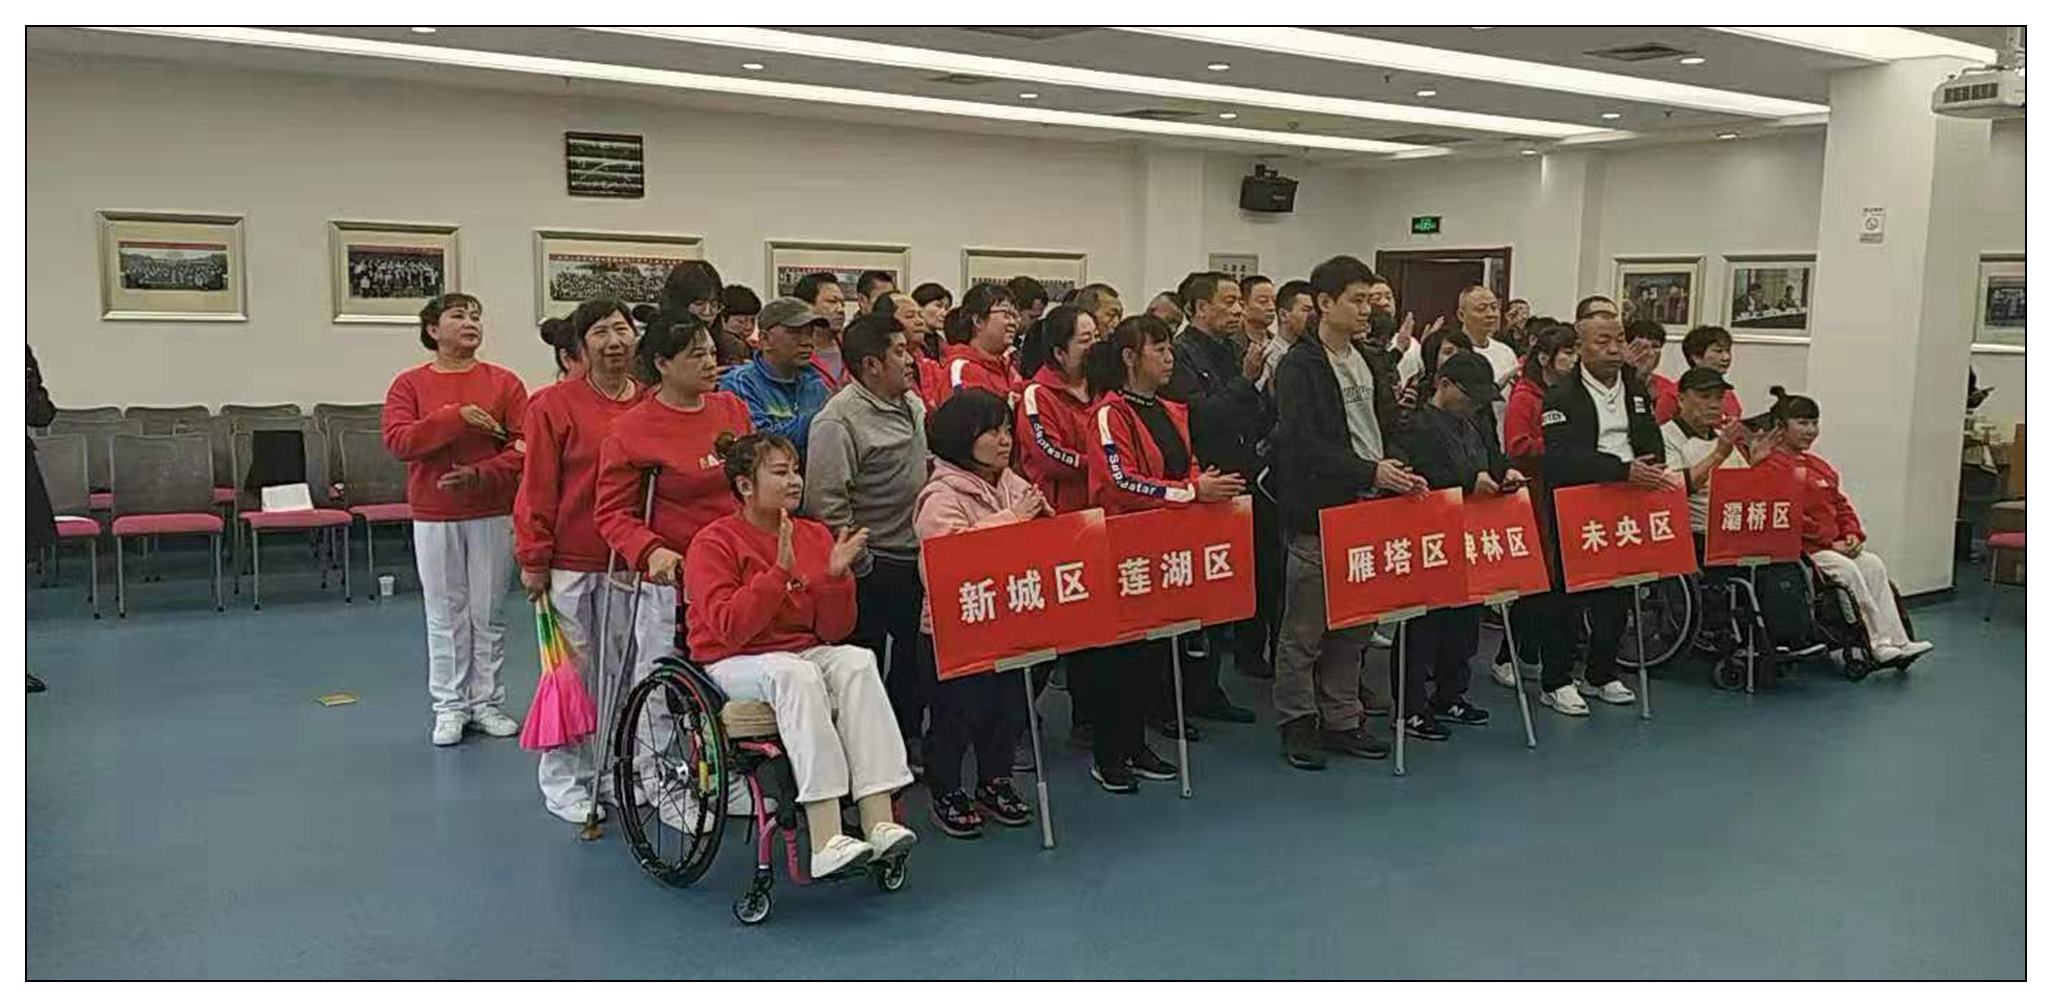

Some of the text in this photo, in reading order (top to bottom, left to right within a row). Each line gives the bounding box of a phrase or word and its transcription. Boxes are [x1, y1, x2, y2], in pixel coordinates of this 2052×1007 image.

[1581, 510, 1675, 552] 未央区
[1721, 501, 1791, 531] 灞桥区
[1118, 543, 1234, 597] 莲湖区
[1347, 533, 1448, 583] 雁塔区
[959, 561, 1089, 624] 新城区
